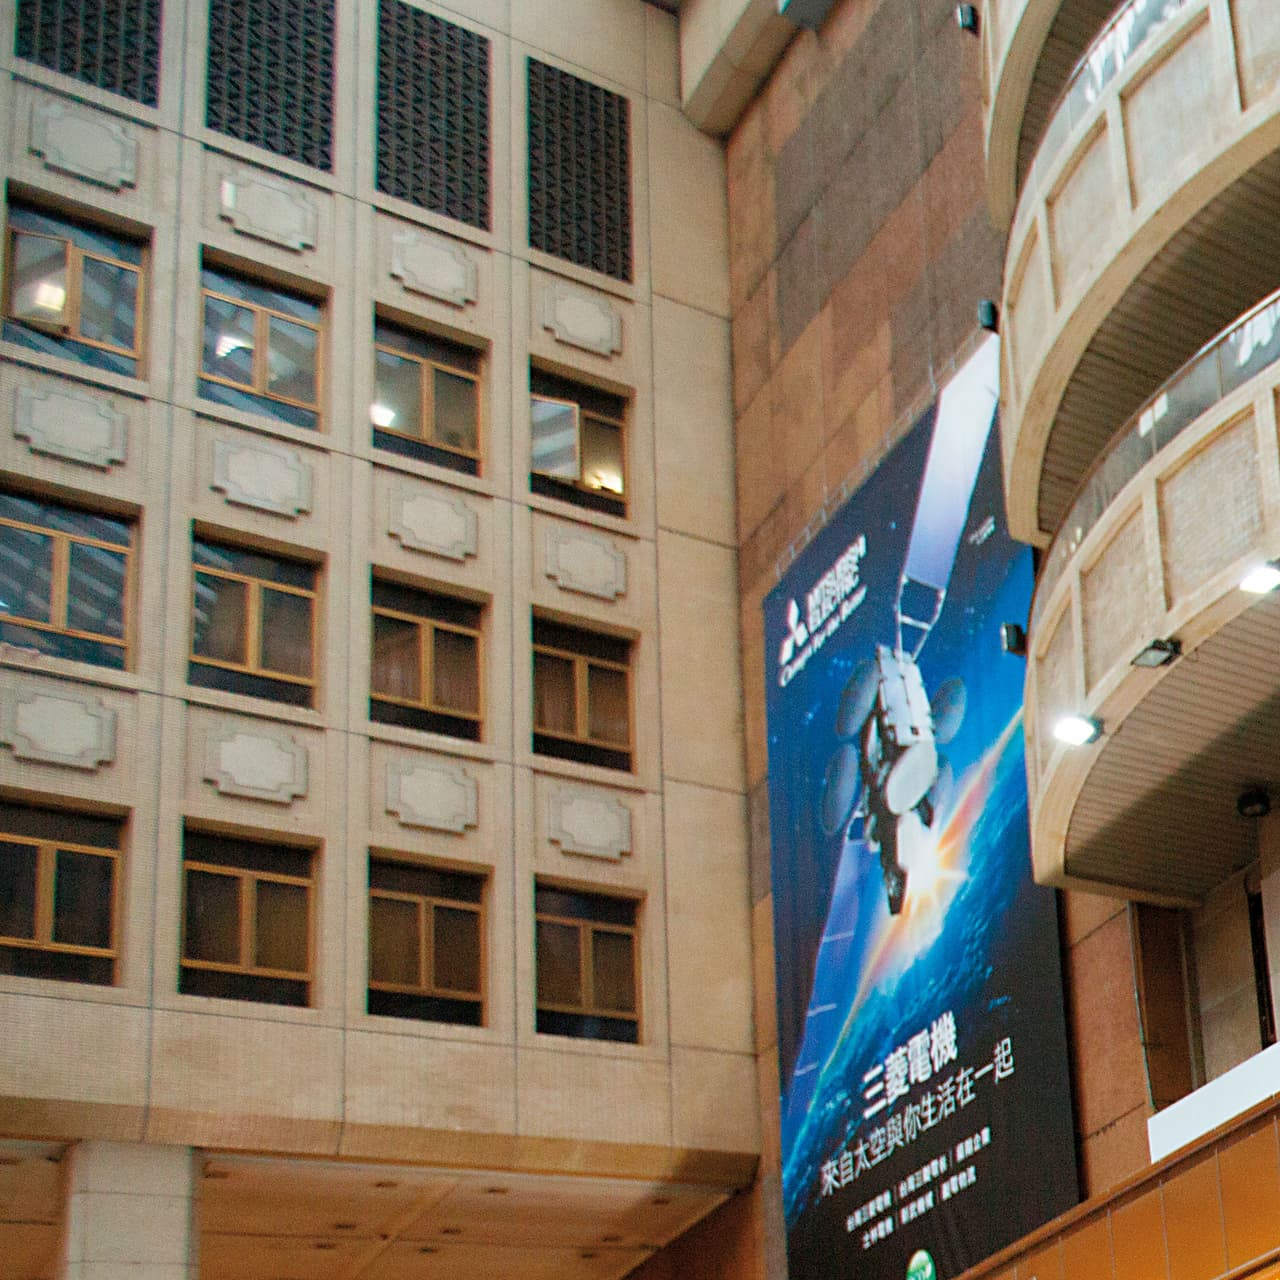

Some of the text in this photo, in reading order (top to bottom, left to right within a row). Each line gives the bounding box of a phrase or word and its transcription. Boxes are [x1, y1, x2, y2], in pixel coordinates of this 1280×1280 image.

[820, 1036, 1015, 1197] 來自太空與你生活在一起
[863, 1010, 958, 1120] 三菱電機
